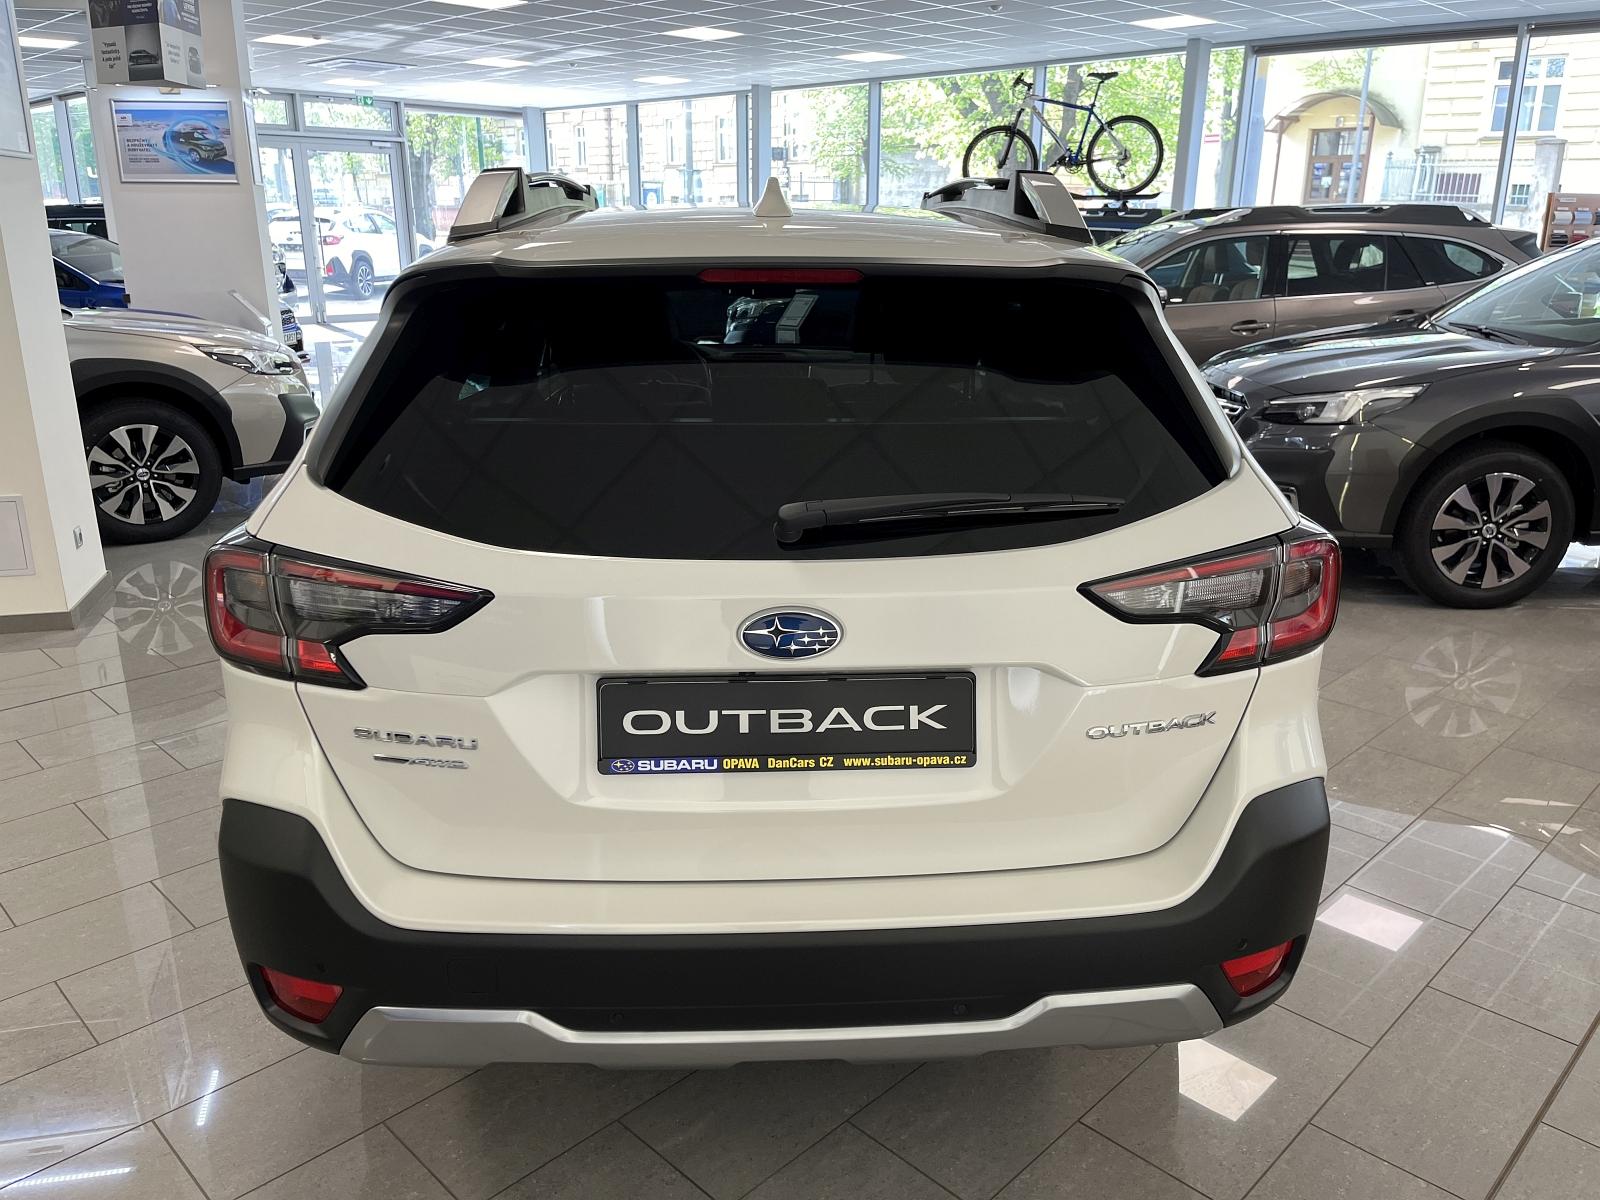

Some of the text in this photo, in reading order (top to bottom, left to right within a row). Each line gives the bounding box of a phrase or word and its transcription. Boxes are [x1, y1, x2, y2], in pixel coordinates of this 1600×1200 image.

[622, 704, 948, 735] OUTBACK
[1086, 711, 1217, 739] OUTBACK
[353, 727, 479, 750] SUBARU
[637, 755, 967, 771] SUBARU OPAVA DanCars CZ www.subaru-opava.cz
